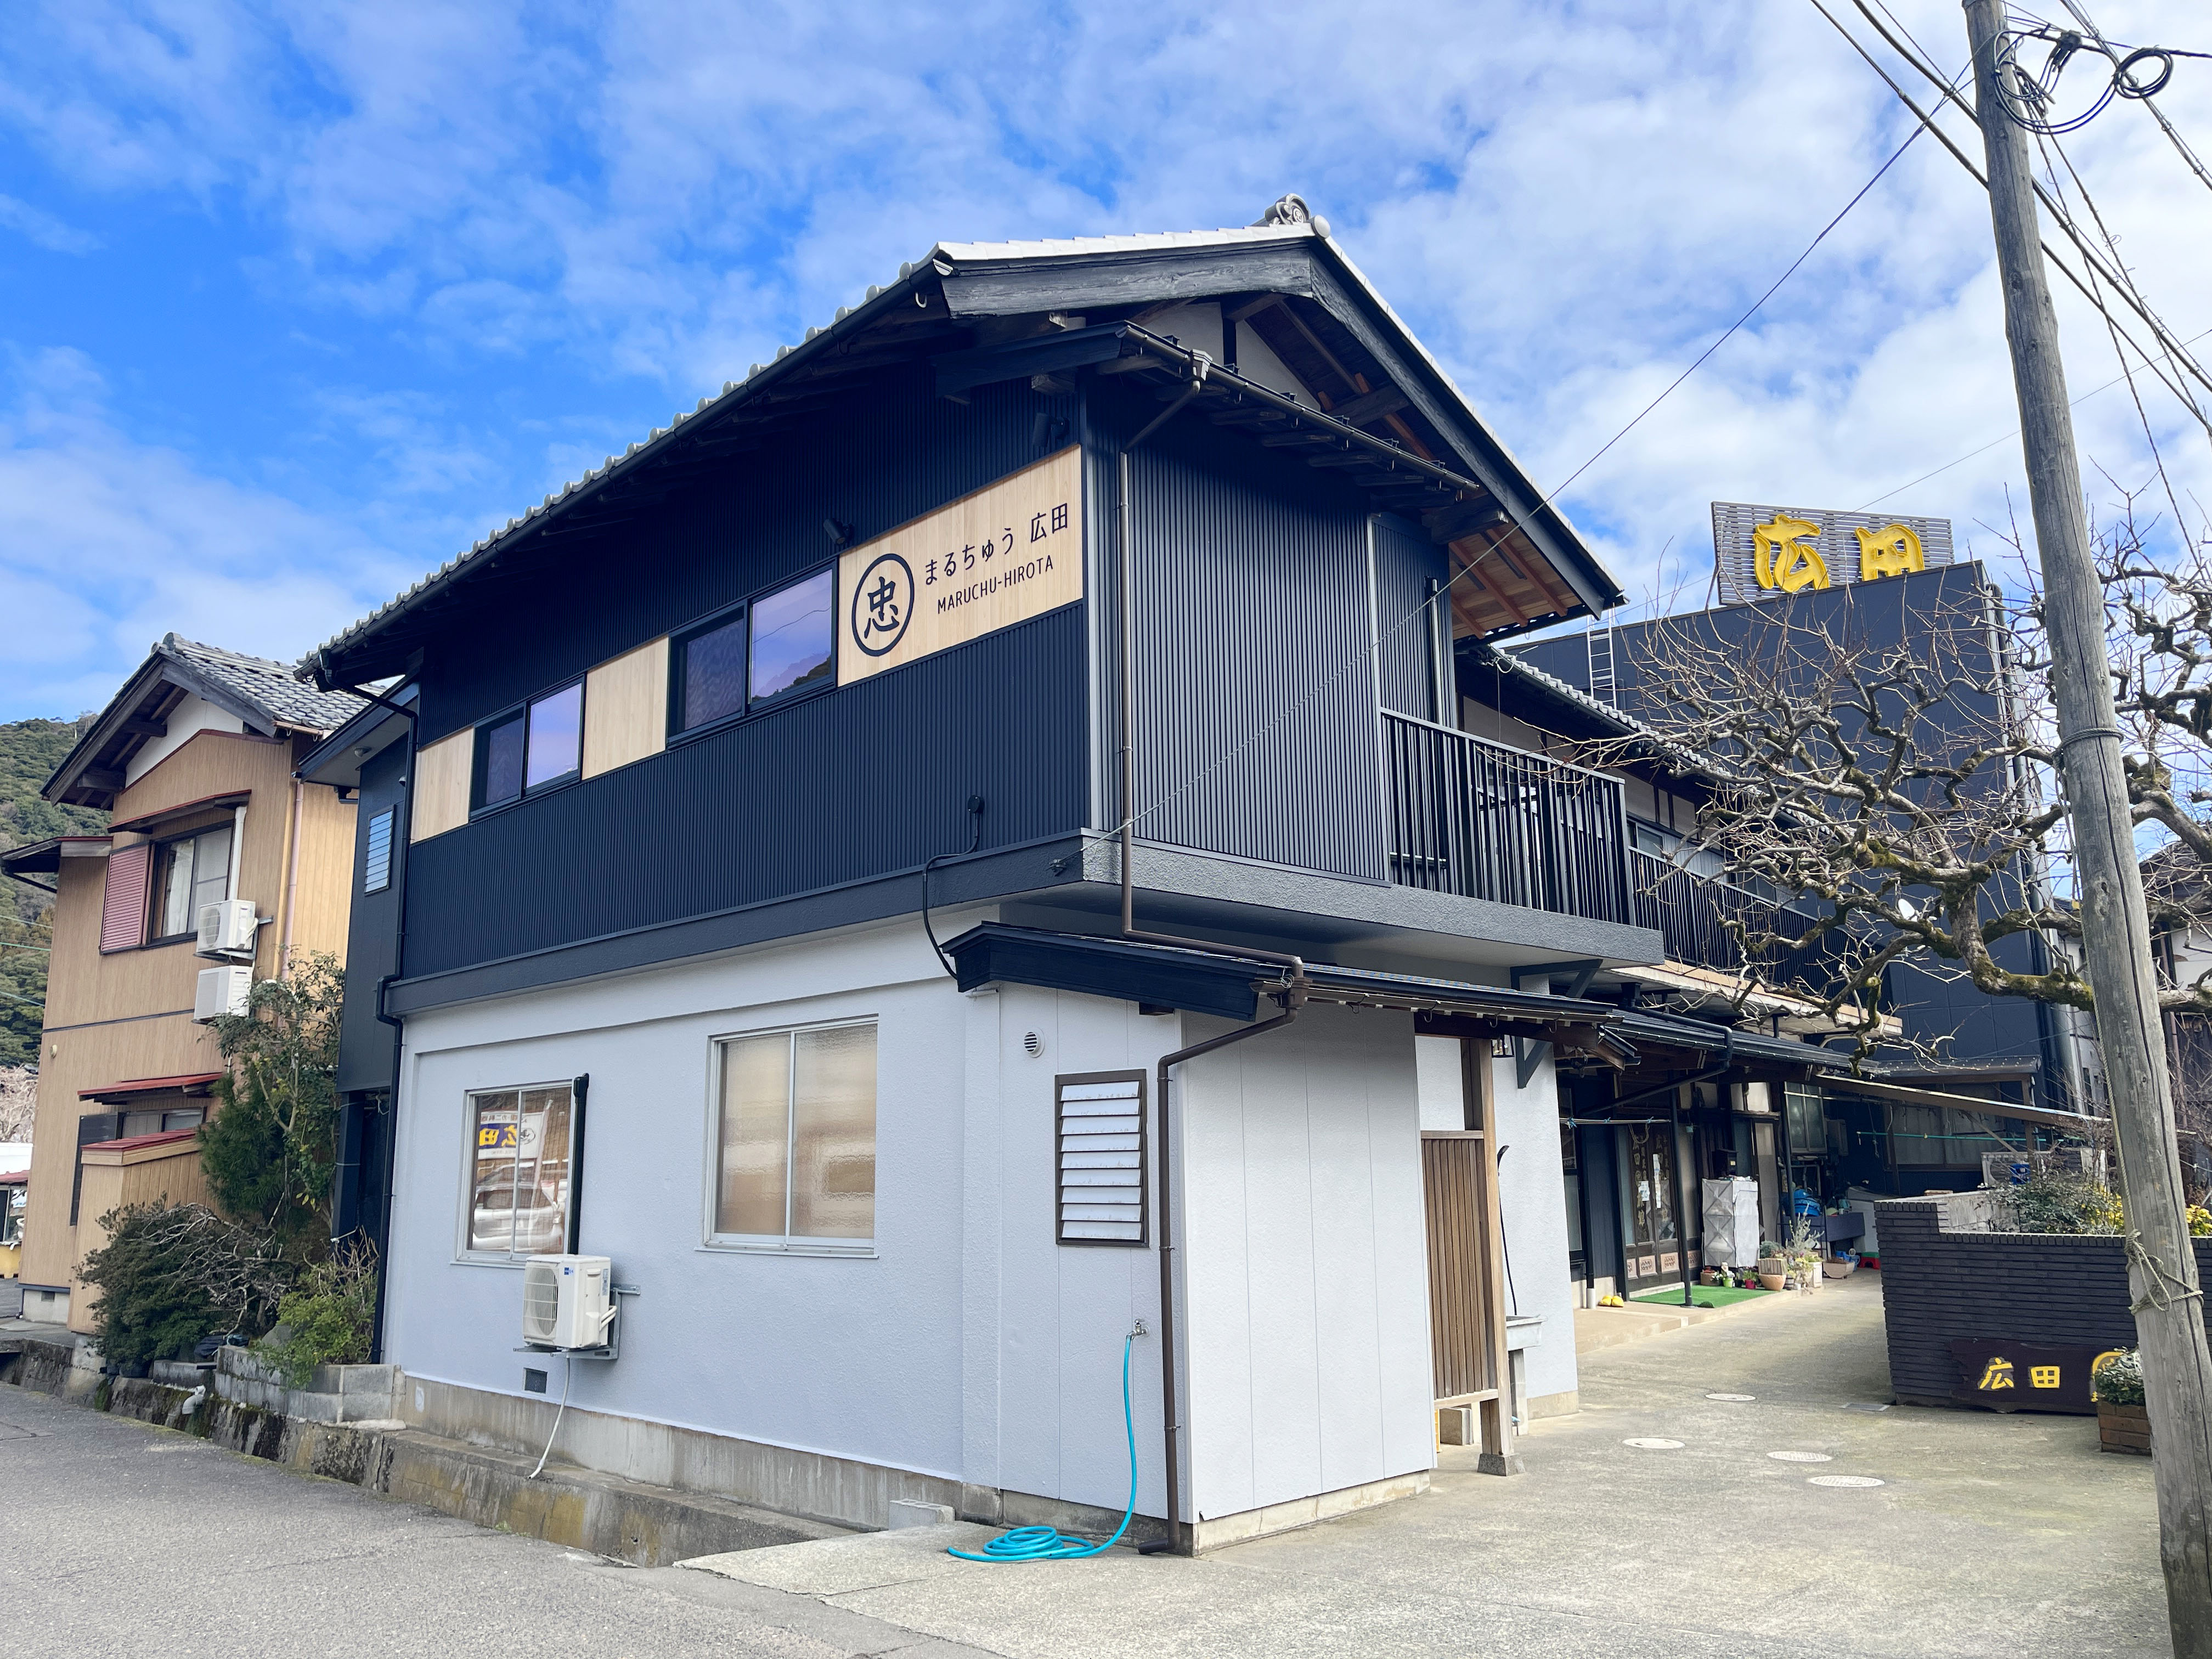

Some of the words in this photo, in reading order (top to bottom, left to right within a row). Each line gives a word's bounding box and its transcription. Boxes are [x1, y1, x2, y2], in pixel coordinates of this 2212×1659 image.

[925, 527, 1014, 586] まるちゅう
[1030, 503, 1068, 543] 広田
[1753, 514, 1925, 592] 広田
[937, 555, 1053, 614] MARUCHU-HIROTA
[1979, 1357, 2061, 1389] 広田
